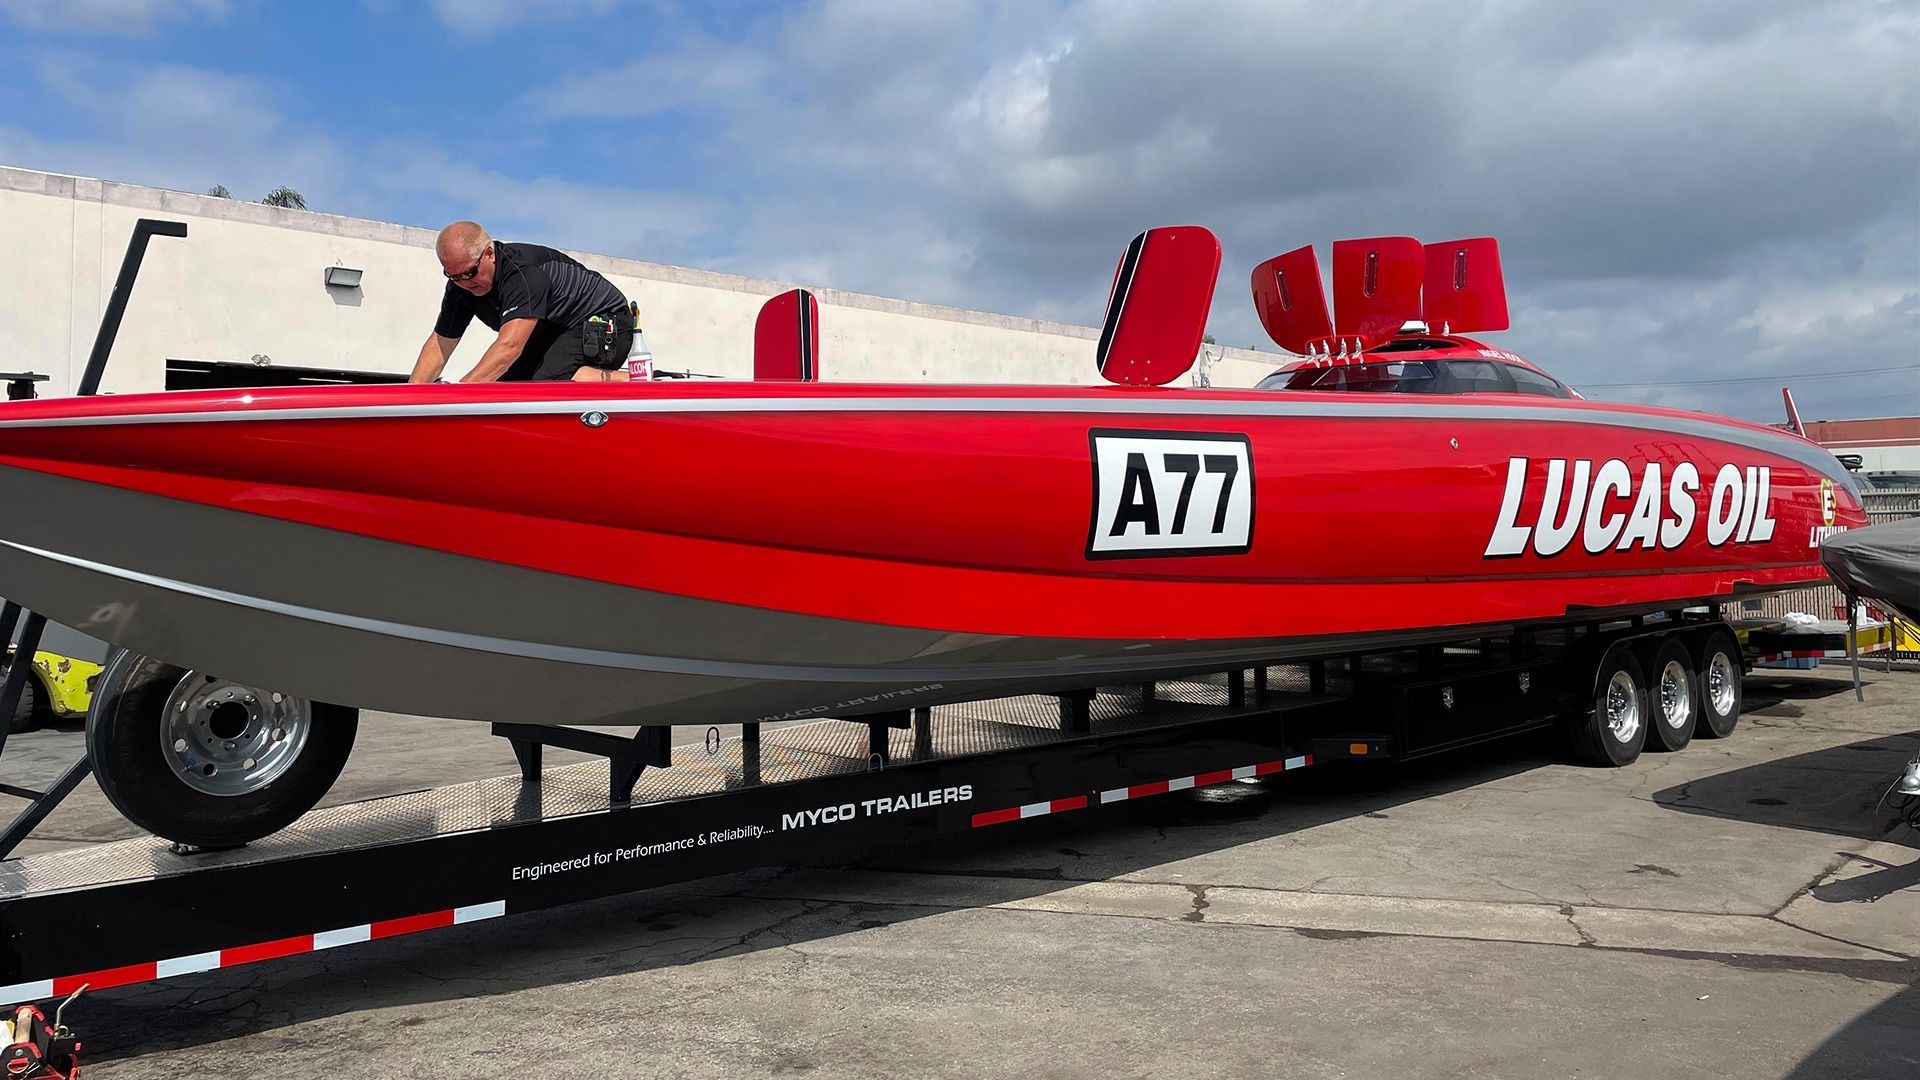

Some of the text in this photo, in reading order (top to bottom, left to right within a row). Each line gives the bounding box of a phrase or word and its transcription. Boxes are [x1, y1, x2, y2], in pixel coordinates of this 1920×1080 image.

[1108, 452, 1239, 537] A77
[1483, 457, 1777, 558] LUCAS OIL
[1808, 525, 1848, 548] LITH
[512, 853, 591, 881] Engineered
[594, 851, 613, 866] for
[615, 838, 695, 862] Performance
[697, 833, 707, 846] &
[782, 803, 856, 831] MYCO
[861, 784, 973, 817] TRAILERS
